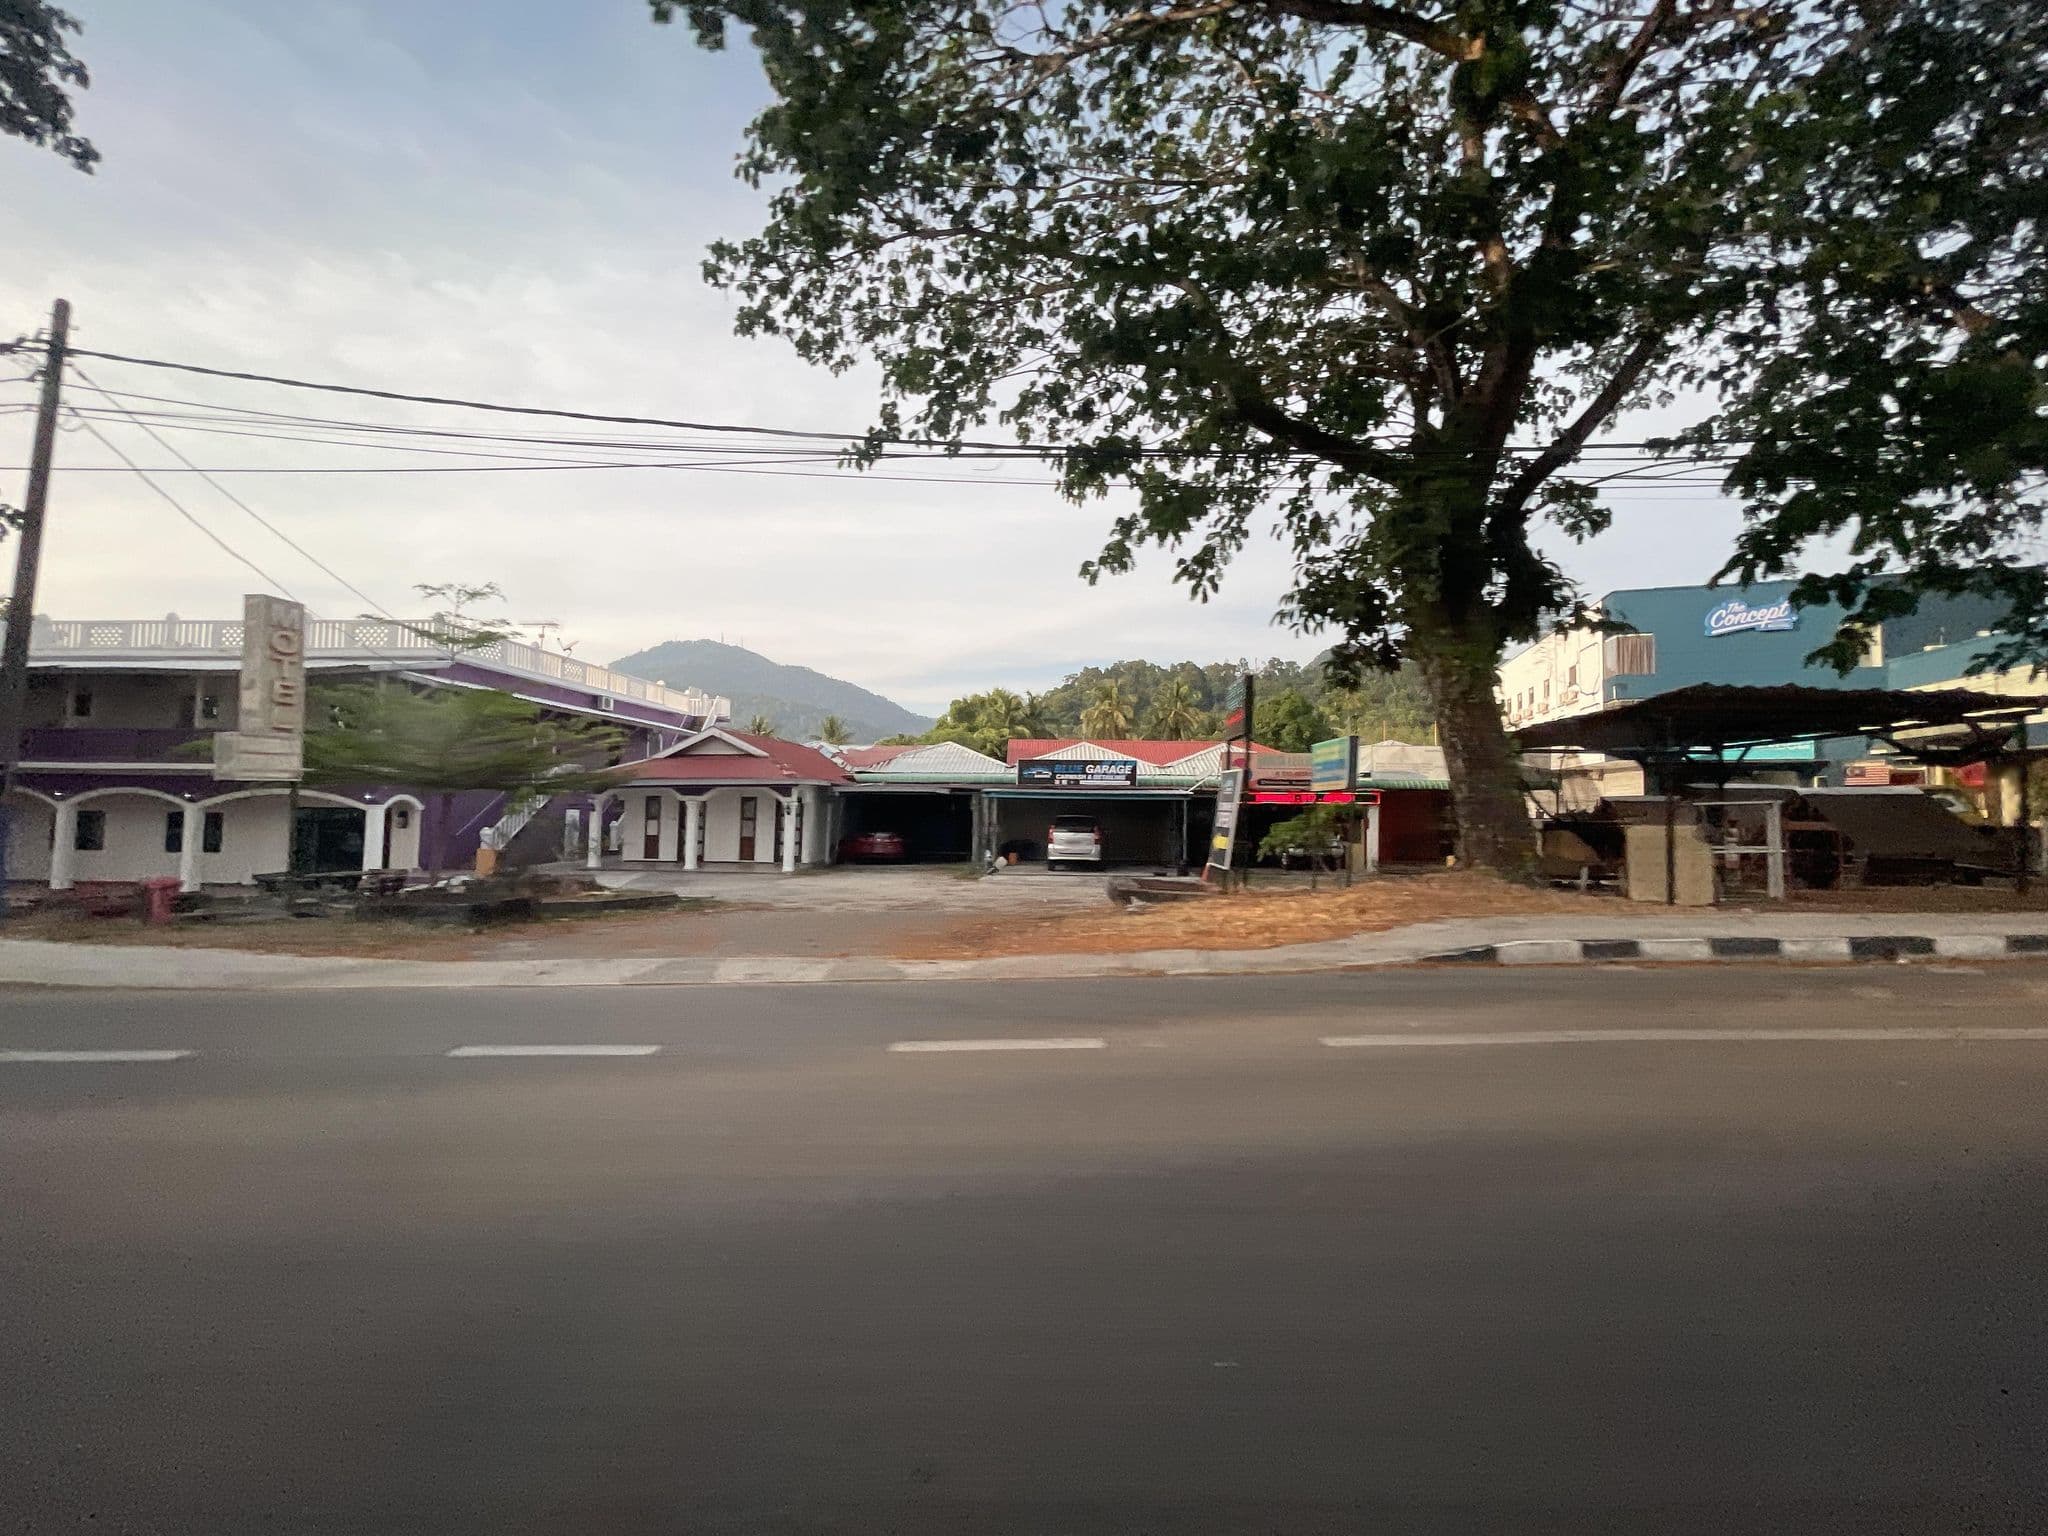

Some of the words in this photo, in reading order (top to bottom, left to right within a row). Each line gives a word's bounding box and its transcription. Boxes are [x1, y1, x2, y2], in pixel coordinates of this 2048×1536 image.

[1728, 602, 1745, 613] The
[1710, 601, 1790, 628] Concept
[1085, 764, 1133, 774] GARAGE
